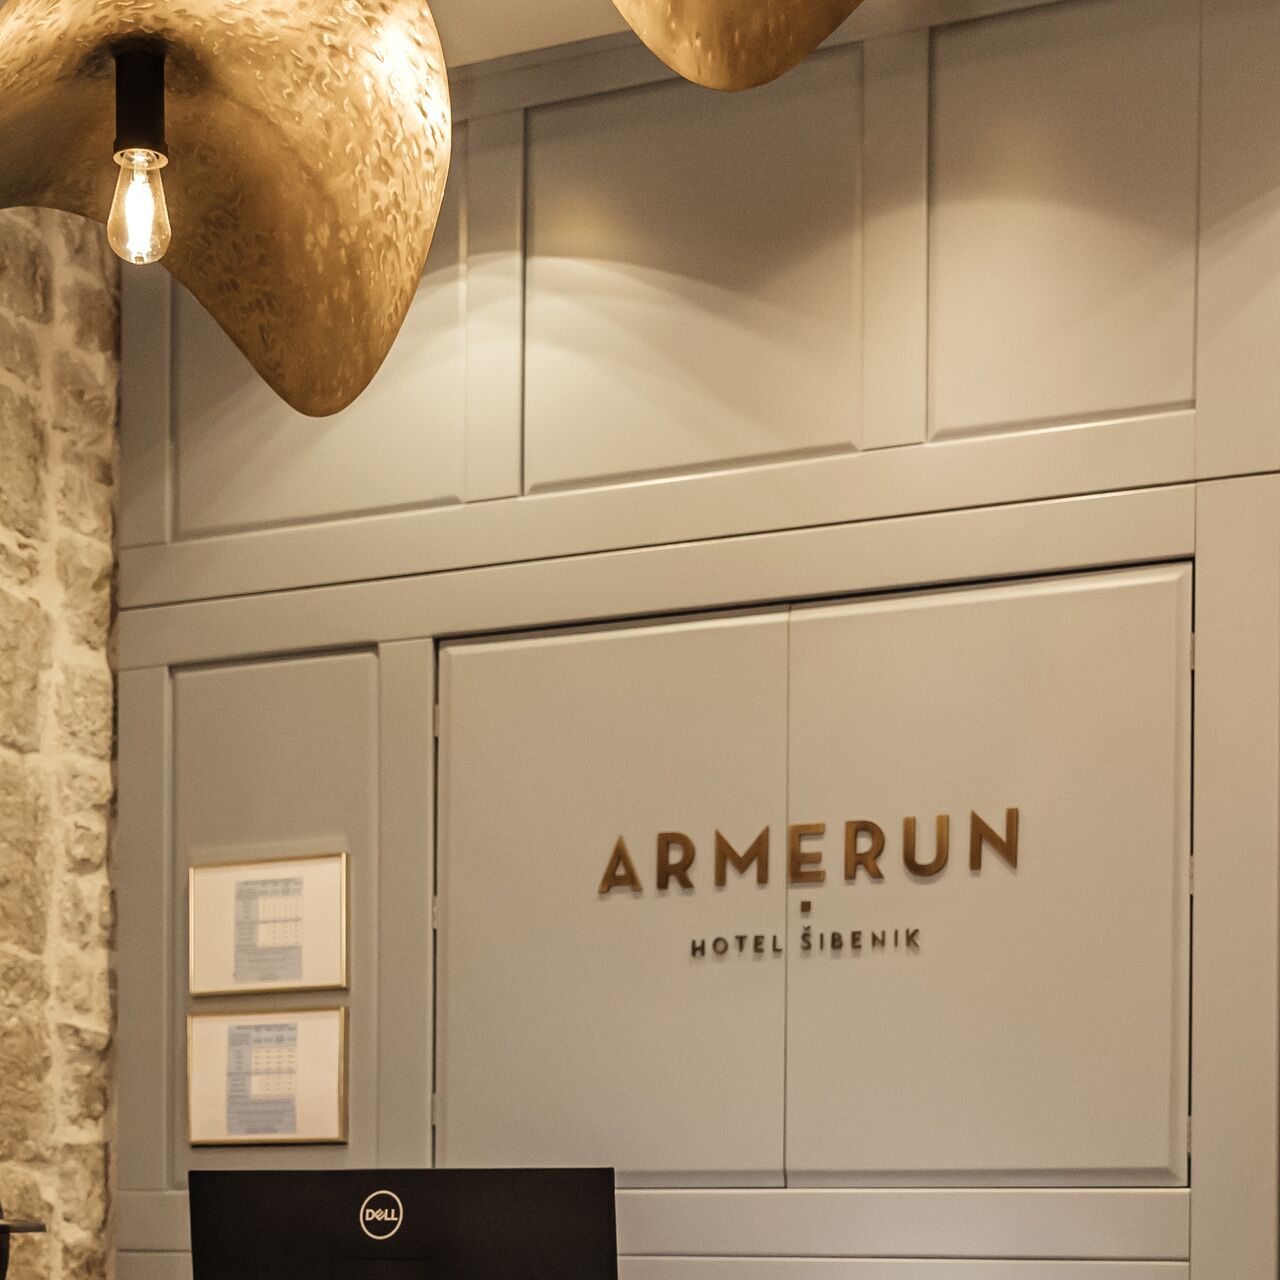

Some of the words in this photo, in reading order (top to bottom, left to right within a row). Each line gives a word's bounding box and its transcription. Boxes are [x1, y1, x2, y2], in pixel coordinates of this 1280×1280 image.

[598, 807, 1019, 894] ARMERUN
[691, 934, 783, 957] HOTEL
[801, 925, 920, 951] ŠIBENIK
[365, 1208, 398, 1221] DELL
